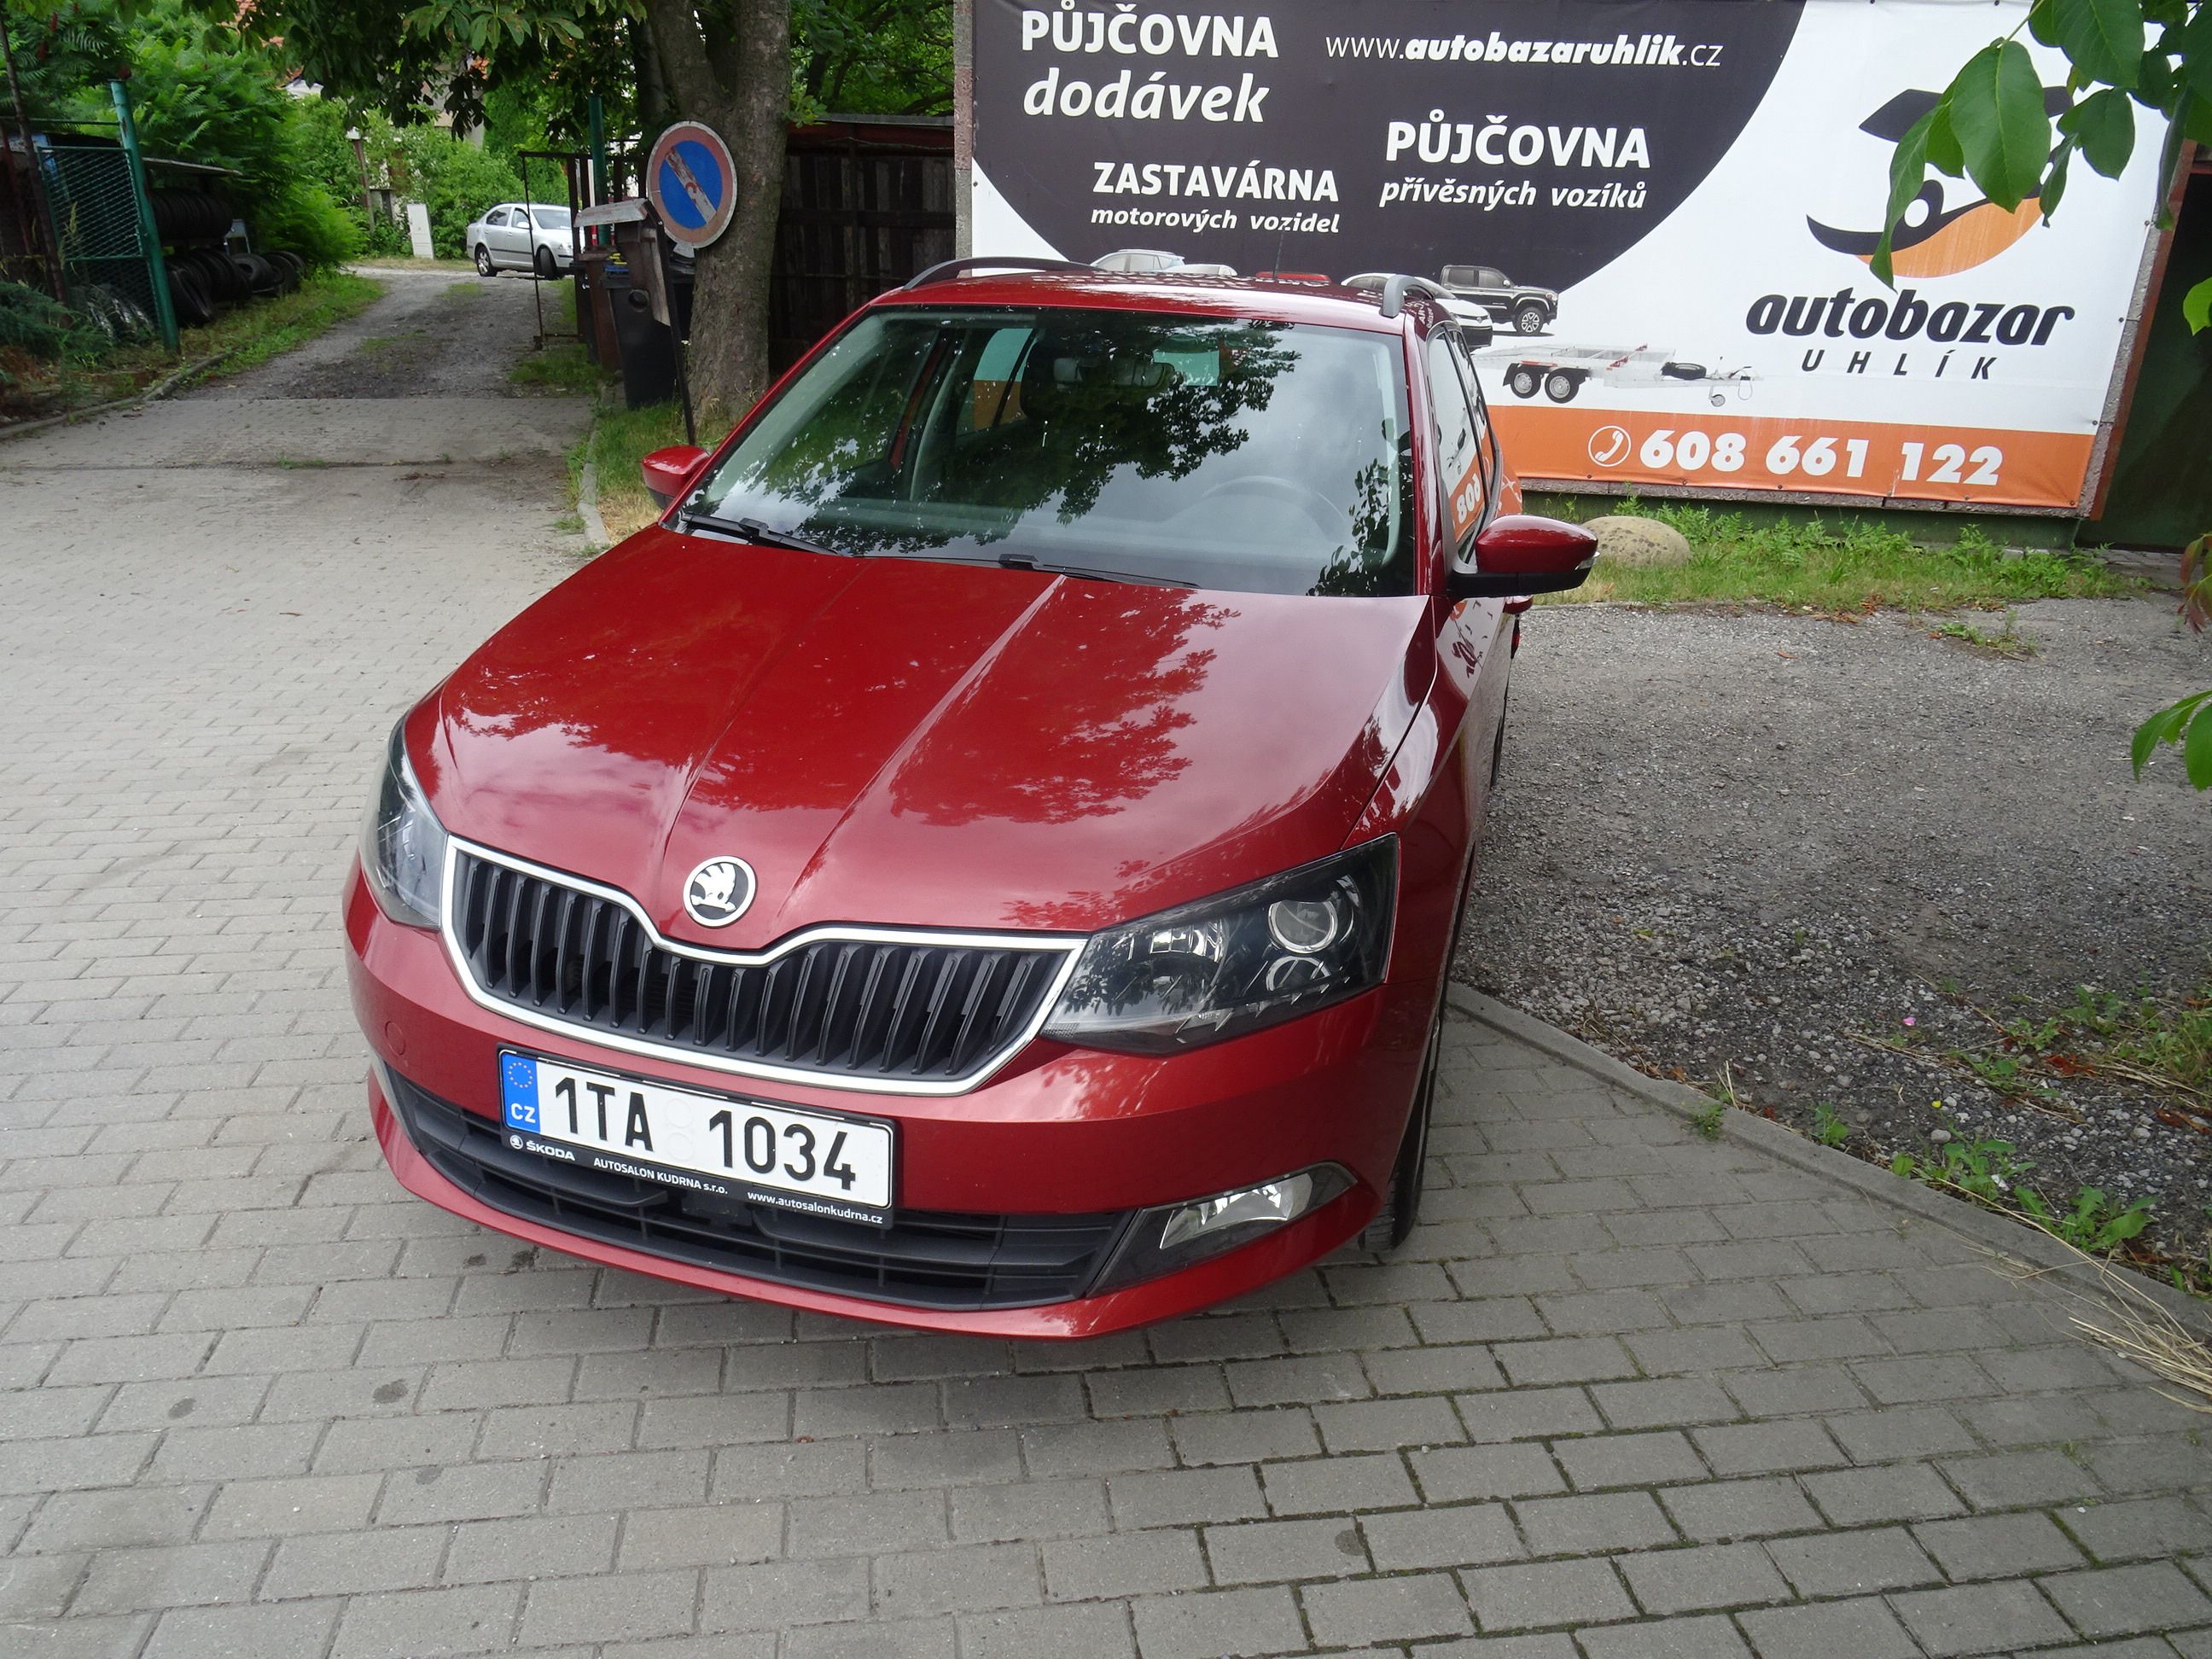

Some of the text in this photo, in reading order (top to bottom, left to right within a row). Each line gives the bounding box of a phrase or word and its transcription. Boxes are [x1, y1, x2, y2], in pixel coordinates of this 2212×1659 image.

[1022, 0, 1278, 58] PŮJČOVNA
[1325, 32, 1723, 67] www.autobazaruhlik.cz
[1023, 67, 1270, 123] dodávek
[1385, 108, 1650, 169] PŮJČOVNA
[1091, 160, 1339, 202] ZASTAVÁRNA
[1379, 176, 1647, 211] přívěsných vozíků
[1091, 207, 1340, 234] motorových vozidel
[1746, 287, 2075, 346] autobazar
[1639, 429, 2005, 486] 608 661 122
[510, 1102, 536, 1124] CZ
[526, 1140, 575, 1161] ŠKODA
[555, 1077, 856, 1191] 1TA 1034
[593, 1157, 655, 1179] AUTOSALON
[656, 1171, 701, 1191] KUDRNA
[747, 1190, 884, 1225] www.autosalonkudrna.cz
